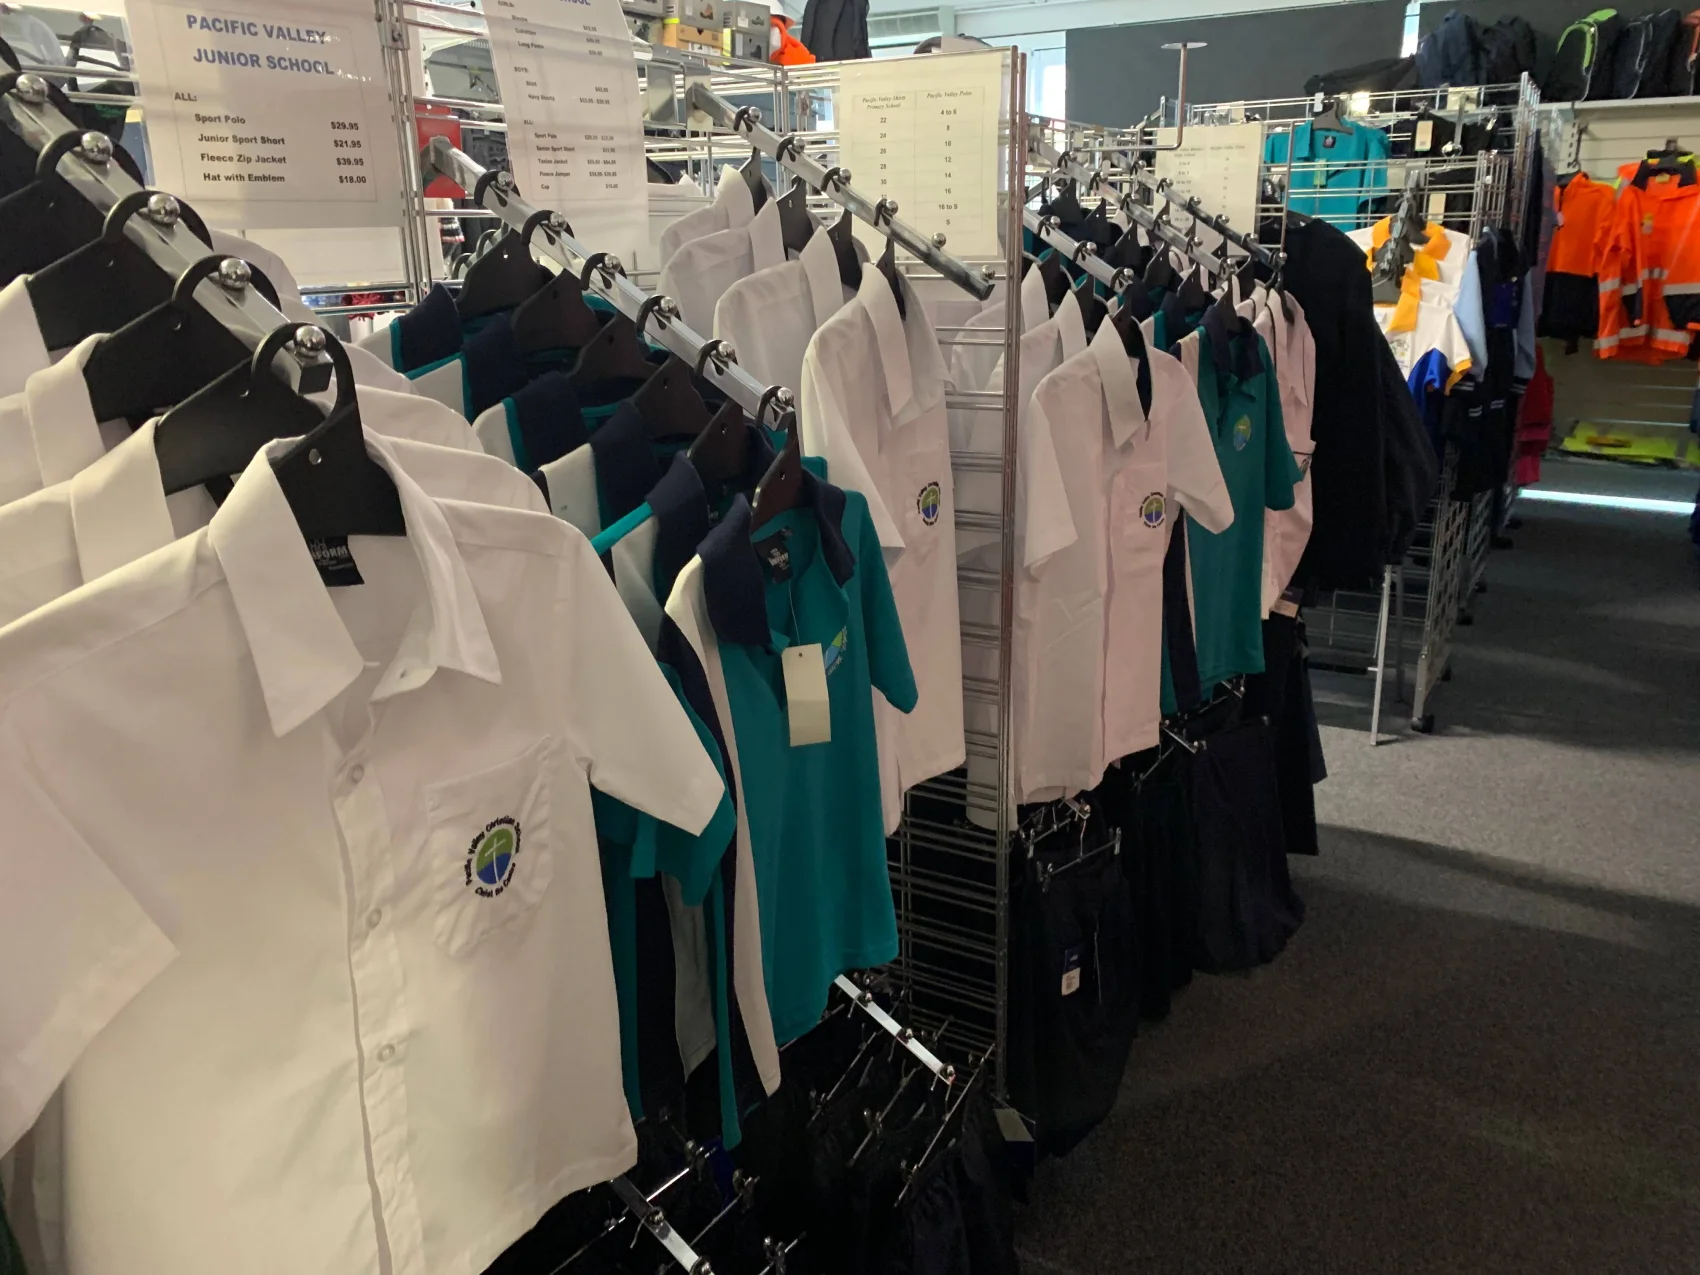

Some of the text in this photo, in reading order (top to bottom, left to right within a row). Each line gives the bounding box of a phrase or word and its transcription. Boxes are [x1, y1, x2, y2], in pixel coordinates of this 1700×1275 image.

[186, 14, 326, 45] PACIFIC VALLEY
[193, 48, 334, 75] JUNIOR SCHOOL
[174, 92, 197, 102] ALL:
[195, 114, 359, 131] Sport Polo $29.95
[198, 133, 362, 149] Junior Sport Short $21.95
[200, 153, 364, 167] Fleece Zip Jacket $39.95
[203, 173, 367, 184] Hat with Emblem $18.00
[468, 831, 485, 855] Valley
[486, 815, 515, 832] Christian
